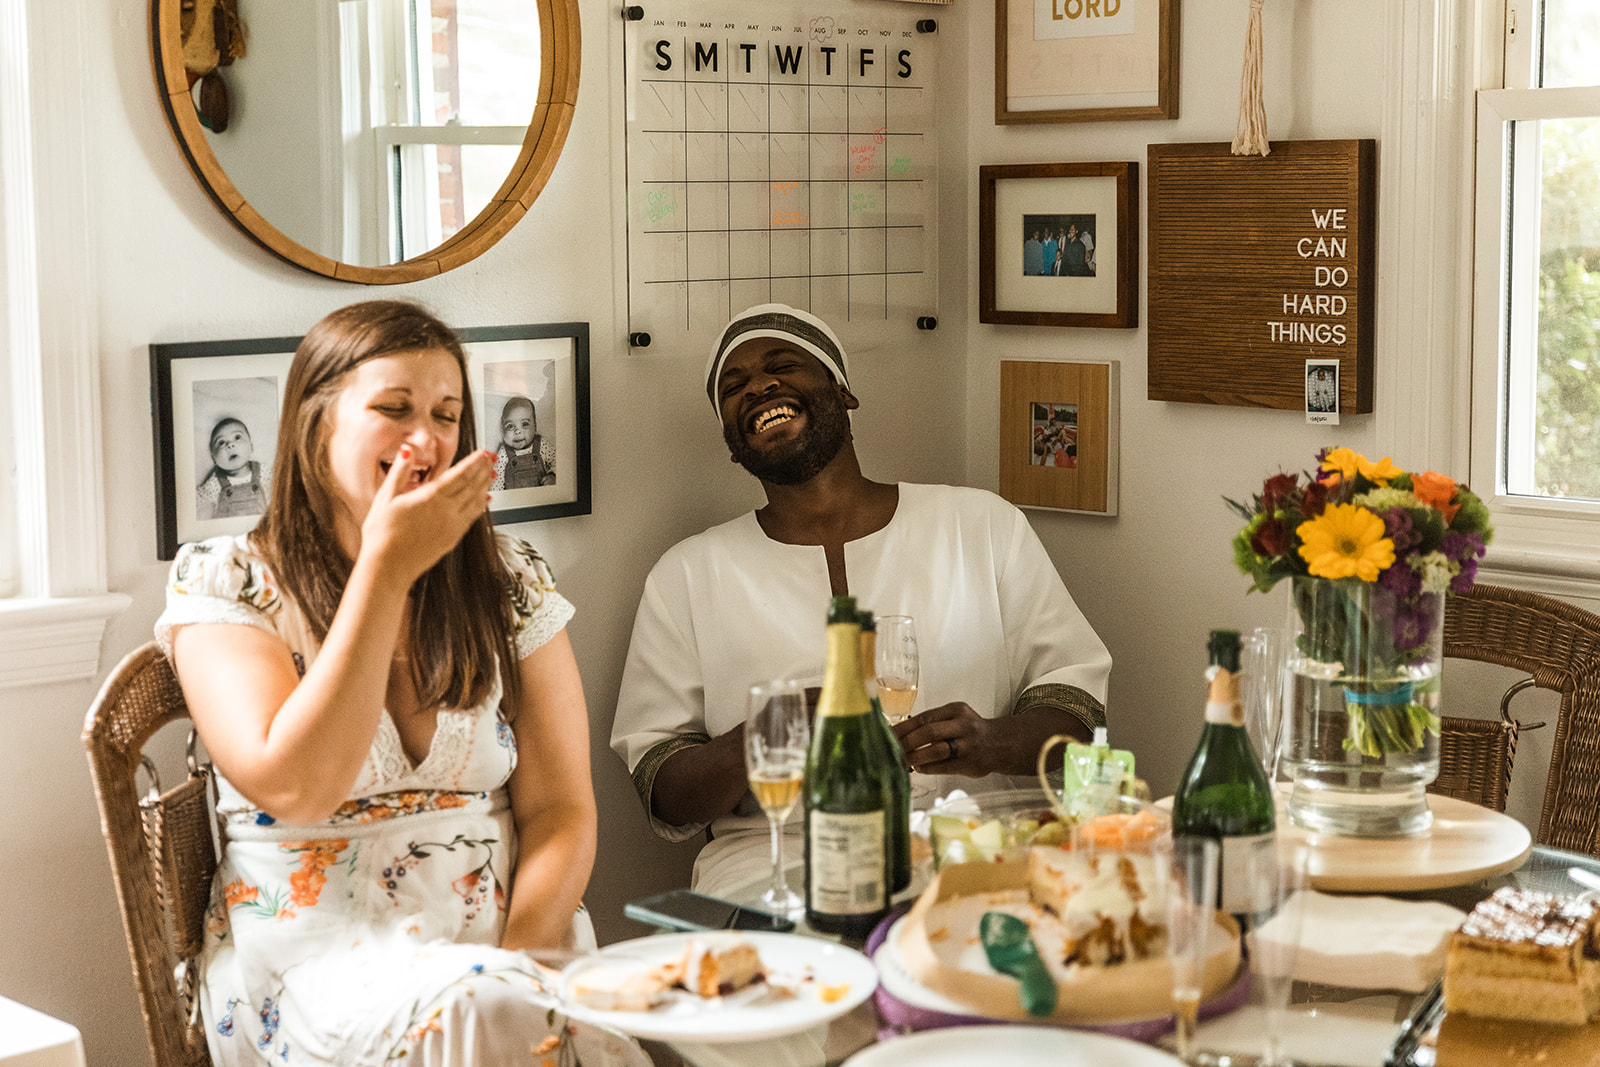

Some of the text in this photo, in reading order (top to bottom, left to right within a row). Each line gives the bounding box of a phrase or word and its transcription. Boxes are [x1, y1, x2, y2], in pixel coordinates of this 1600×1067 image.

[1052, 0, 1121, 21] LORD
[655, 40, 912, 78] S M T W T F S
[1311, 208, 1347, 230] WE
[1297, 236, 1347, 258] CAN
[1315, 266, 1349, 287] DO
[1283, 294, 1347, 316] HARD
[1267, 322, 1347, 345] THINGS
